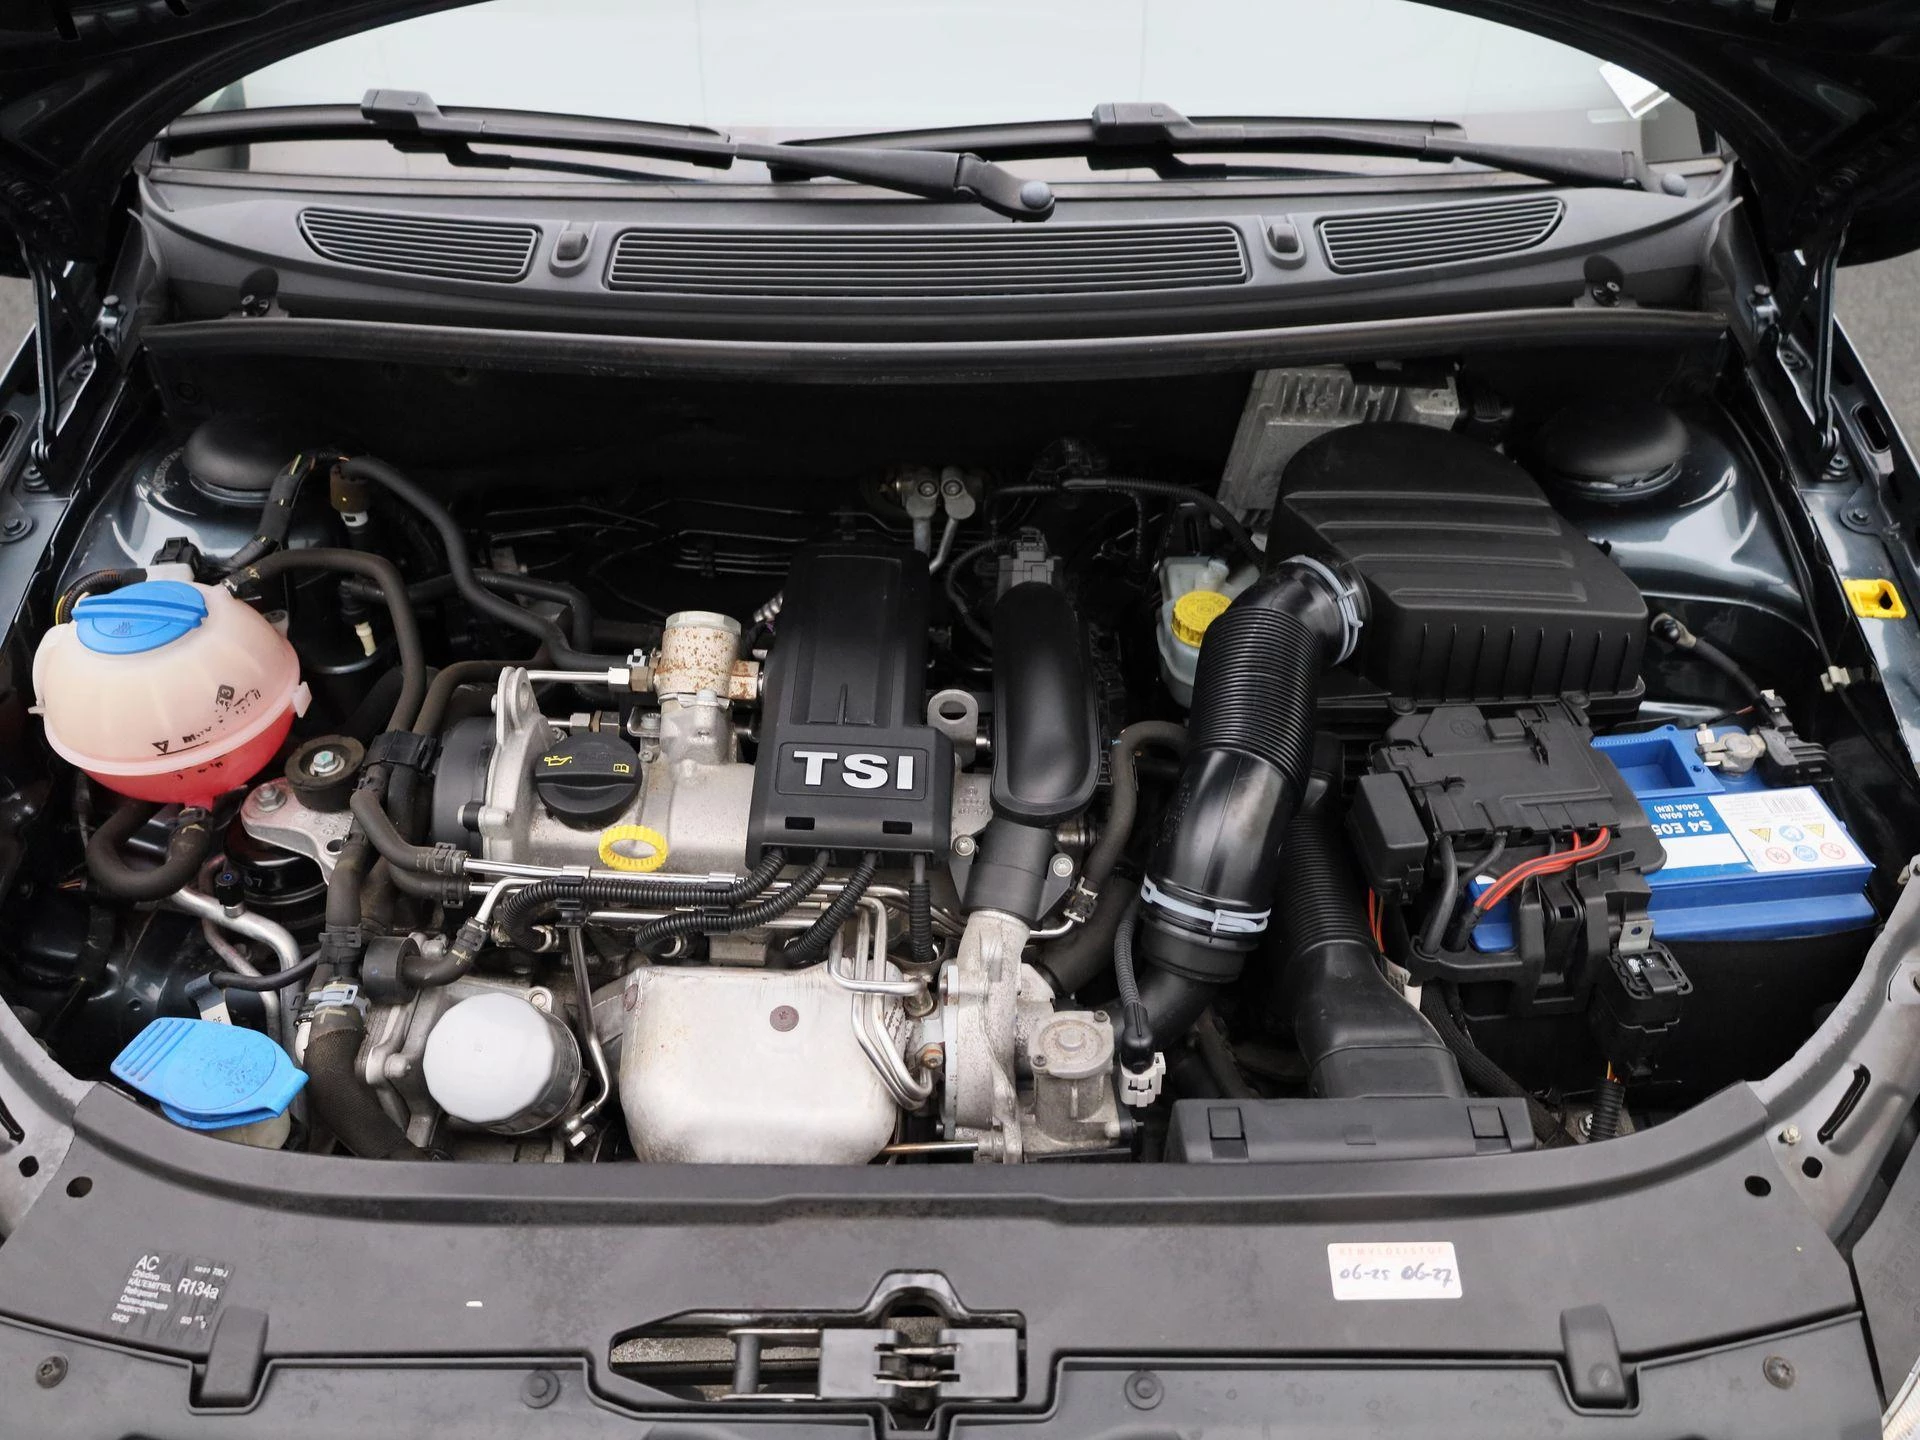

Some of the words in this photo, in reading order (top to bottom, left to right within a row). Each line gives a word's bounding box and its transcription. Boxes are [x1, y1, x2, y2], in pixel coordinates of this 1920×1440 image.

[793, 751, 914, 790] TSI
[1688, 820, 1712, 833] S4
[135, 1255, 160, 1271] AC
[1339, 1263, 1391, 1281] 06-25
[1401, 1262, 1453, 1288] 06-27
[177, 1277, 219, 1300] R134a
